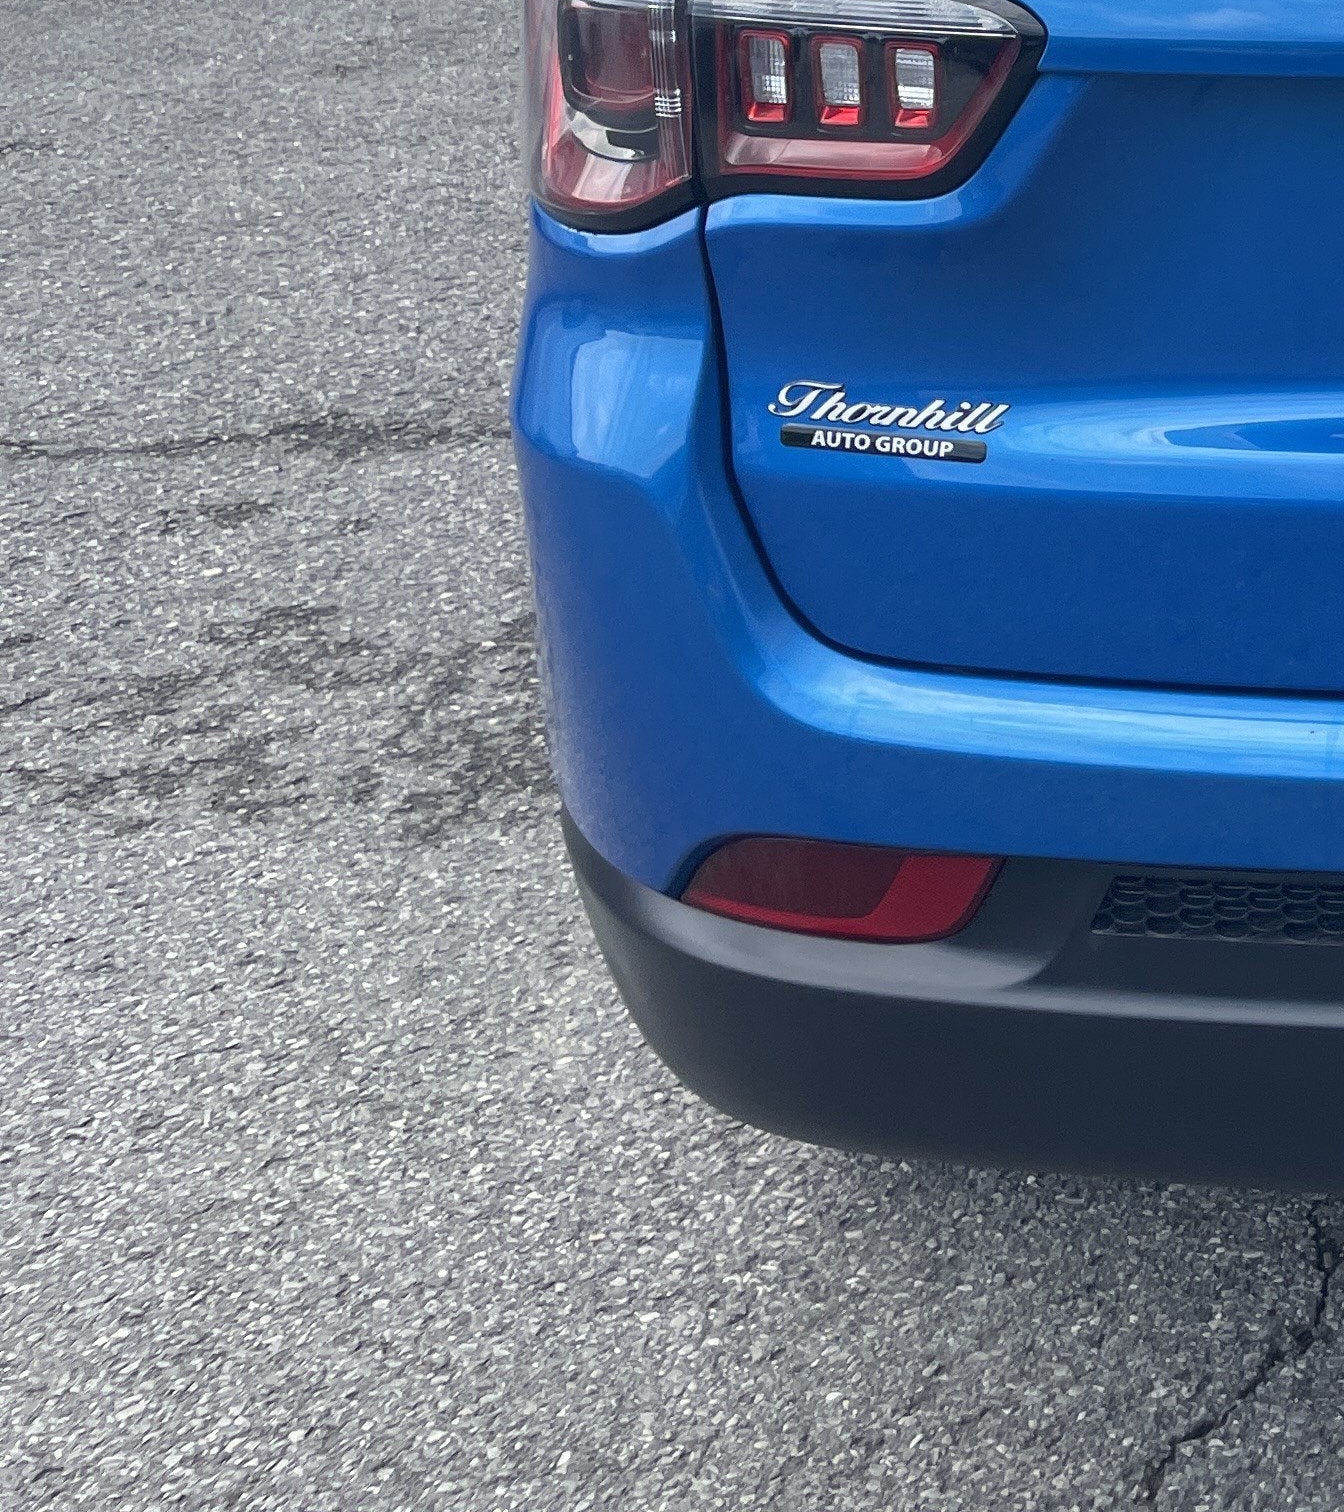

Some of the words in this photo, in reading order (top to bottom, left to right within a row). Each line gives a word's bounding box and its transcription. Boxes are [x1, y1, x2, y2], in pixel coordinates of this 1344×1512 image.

[767, 379, 1010, 434] Thornhill
[810, 429, 871, 451] AUTO
[875, 436, 954, 458] GROUP
